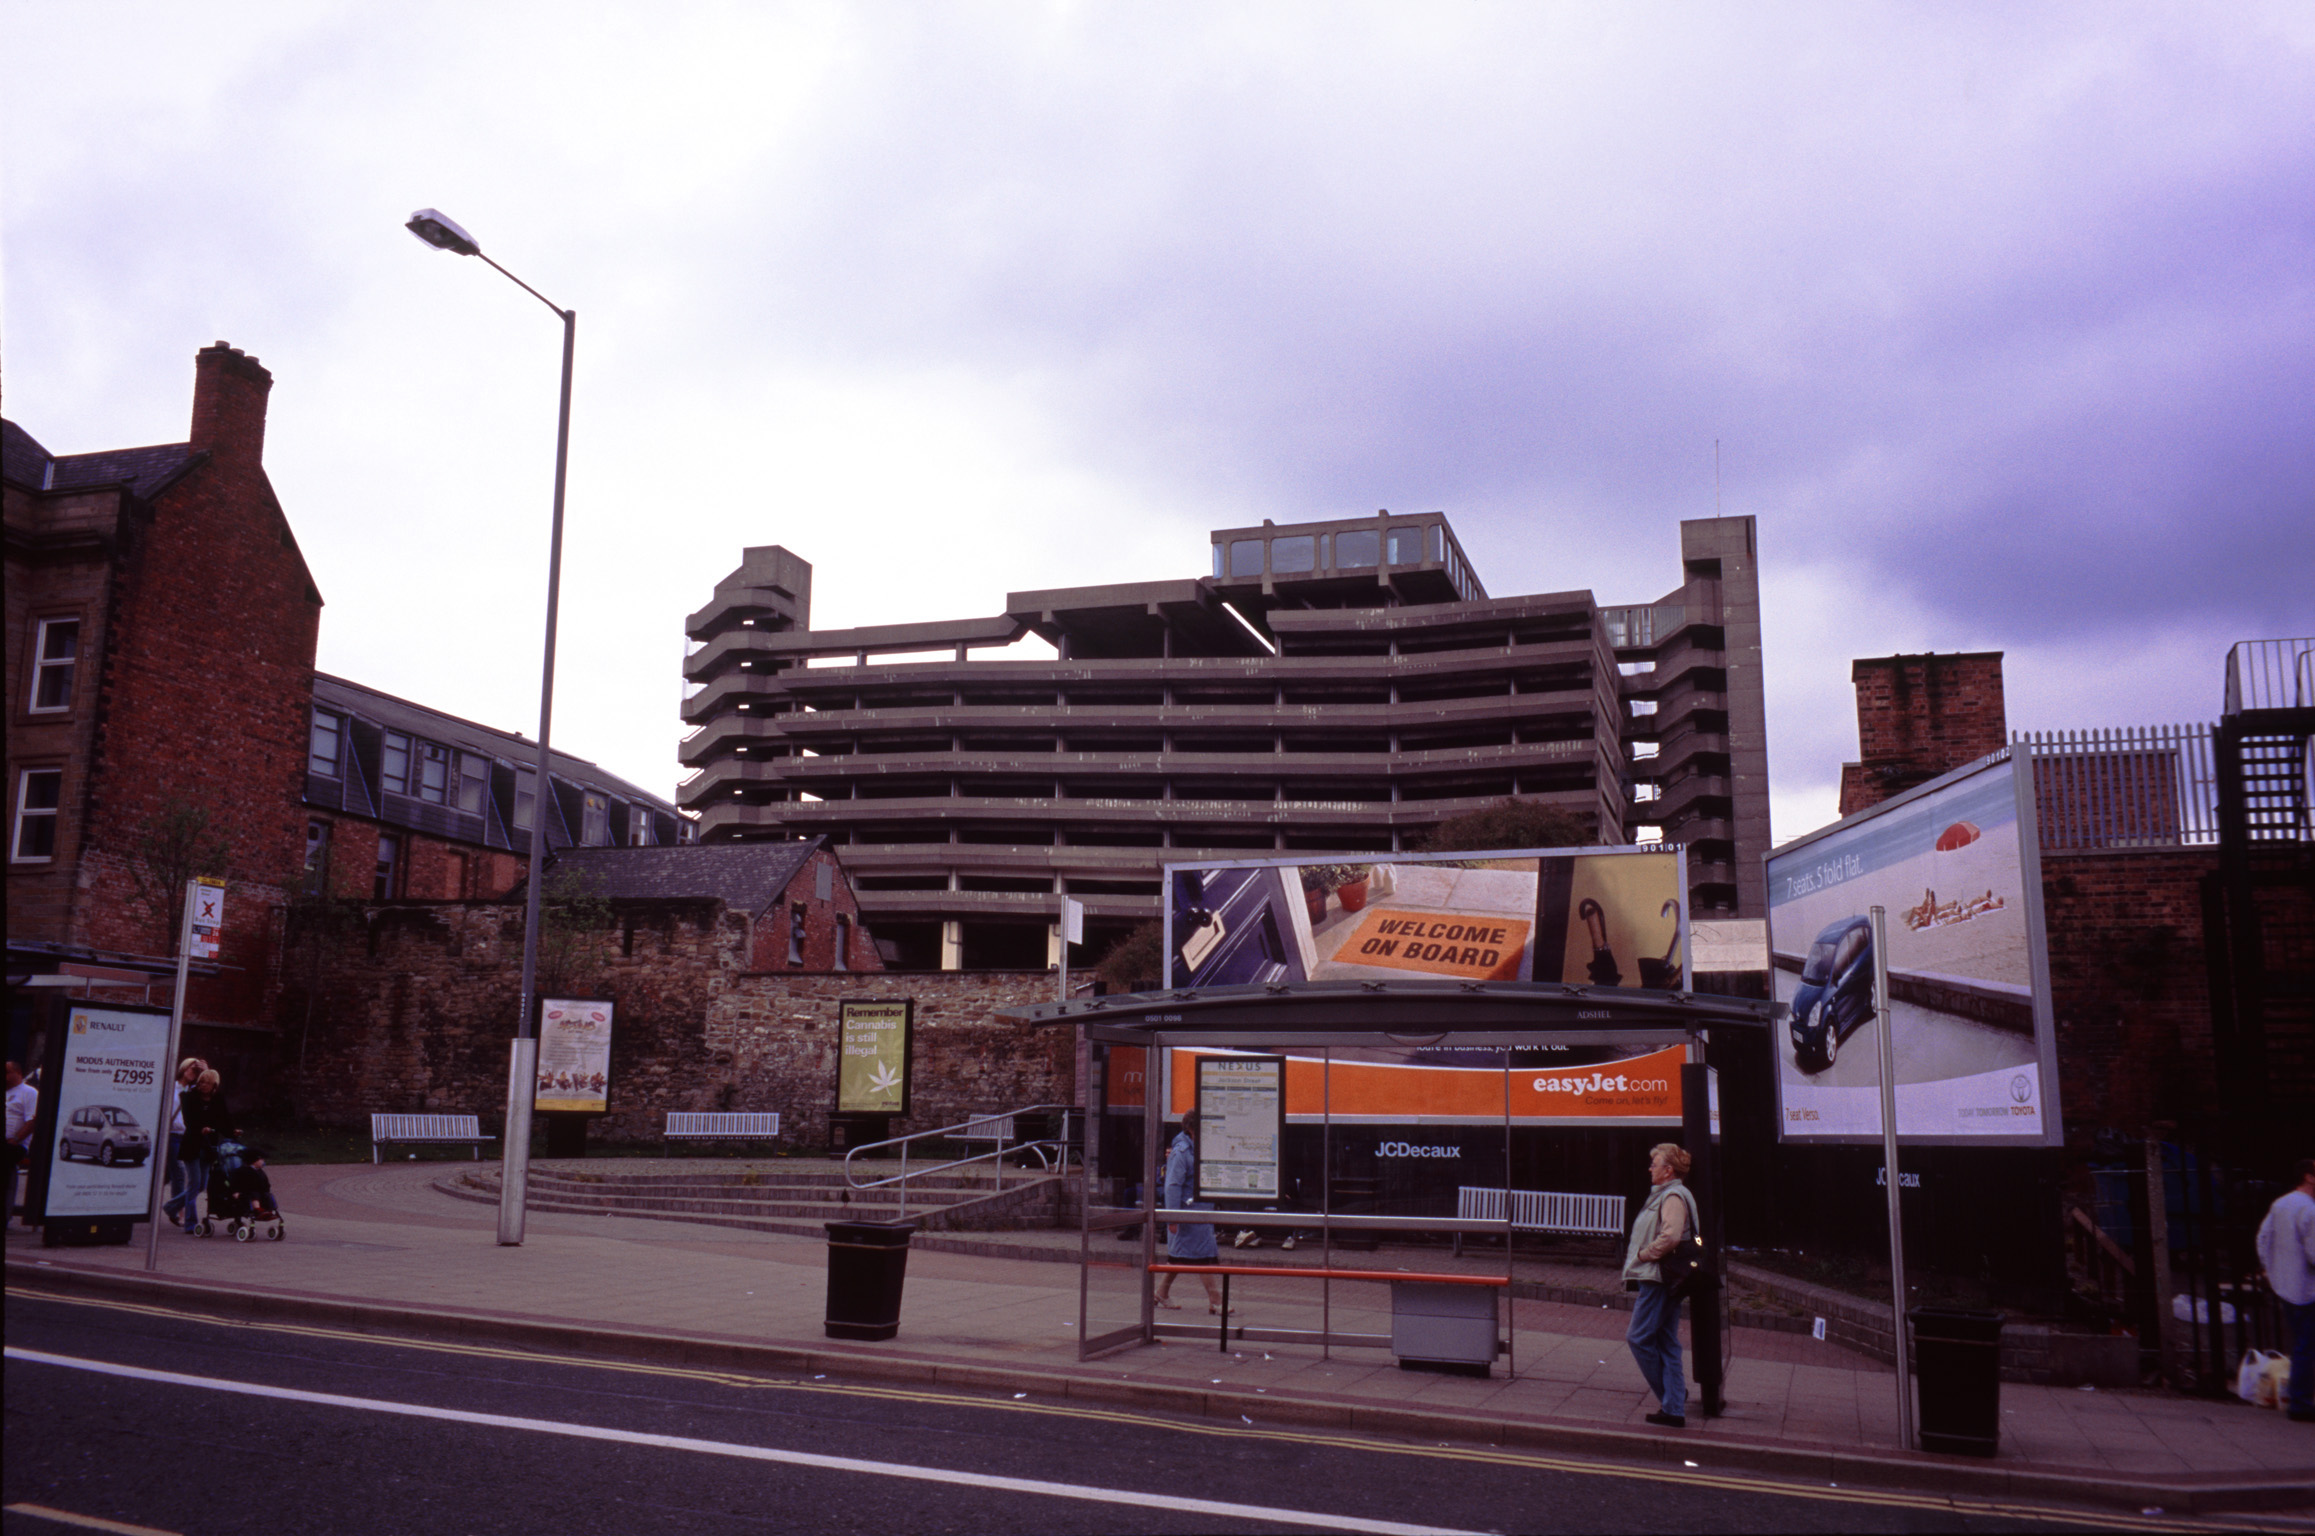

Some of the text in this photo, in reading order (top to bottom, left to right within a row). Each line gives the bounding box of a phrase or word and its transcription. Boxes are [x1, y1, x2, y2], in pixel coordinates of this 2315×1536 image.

[1786, 854, 1864, 899] 7 seats. 5 fold flat.
[1378, 919, 1507, 945] WELCOME
[1360, 938, 1500, 968] ON BOARD
[846, 1007, 904, 1017] Remember
[1577, 1010, 1612, 1019] ADSHEL
[89, 1021, 126, 1032] RENAULT
[846, 1019, 897, 1030] Cannabis
[845, 1032, 877, 1042] is still
[845, 1045, 877, 1057] illegal
[76, 1056, 155, 1069] MODUS AUTHENTIQUE
[1218, 1062, 1261, 1071] NEXUS
[113, 1069, 154, 1085] £7,995
[1533, 1073, 1668, 1096] easyJet.com
[1585, 1096, 1614, 1105] Come
[1631, 1096, 1651, 1105] let's
[2010, 1105, 2036, 1116] TOYOTA
[1374, 1141, 1461, 1158] JCDecaux
[1876, 1167, 1920, 1187] JCcaux
